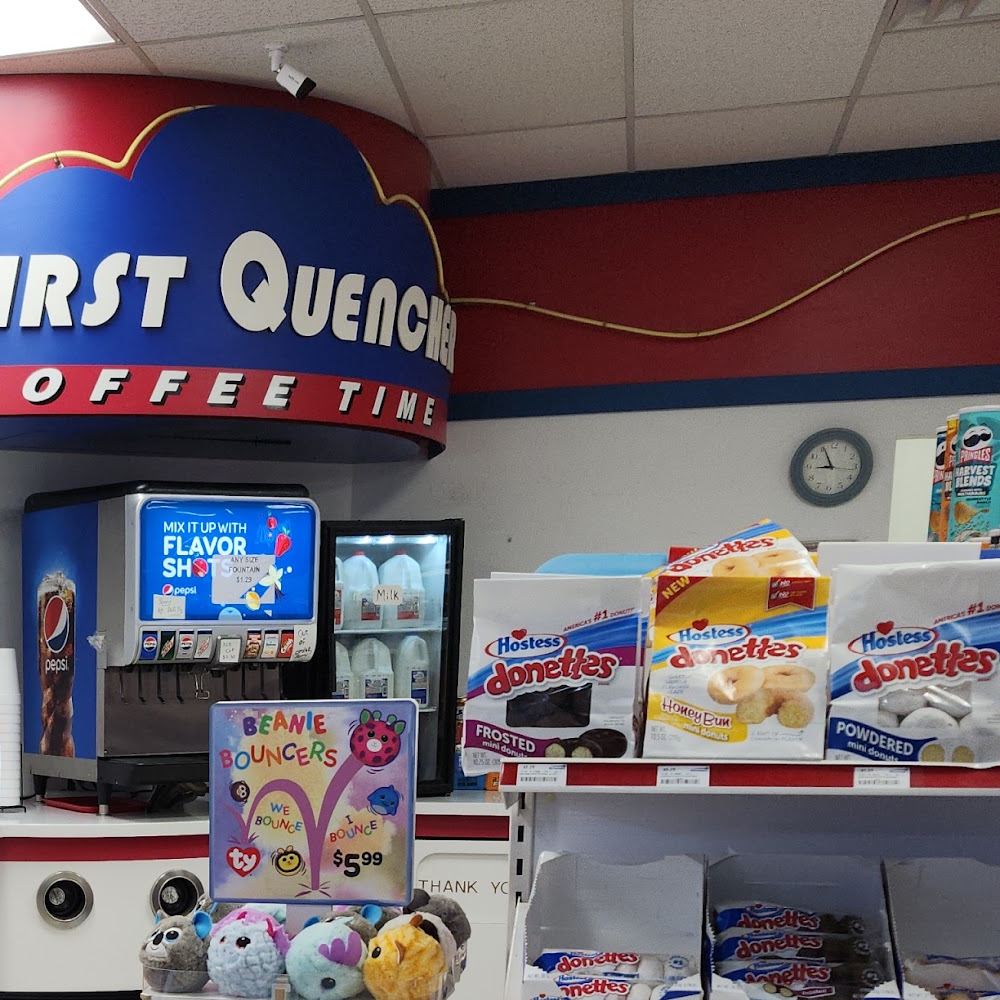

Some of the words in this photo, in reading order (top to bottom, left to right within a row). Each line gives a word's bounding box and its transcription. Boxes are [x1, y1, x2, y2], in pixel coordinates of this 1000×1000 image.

[338, 380, 437, 427] TIME
[960, 448, 992, 463] PRINGLES
[955, 464, 996, 477] HARVEST
[955, 475, 993, 487] BLENDS
[164, 521, 185, 533] MIX
[188, 522, 198, 533] IT
[201, 522, 218, 533] UP
[218, 522, 247, 534] WITH
[163, 536, 247, 556] FLAVOR
[669, 537, 775, 573] donettes
[174, 586, 197, 595] pepsi
[376, 589, 399, 601] Milk
[661, 577, 690, 600] NEW
[594, 610, 609, 622] #1
[967, 601, 984, 616] #1
[678, 625, 744, 643] Hostess
[861, 629, 931, 653] Hostess
[497, 634, 561, 656] Hostess
[669, 637, 801, 669] donettes
[45, 656, 68, 674] pepsi
[487, 648, 616, 697] donettes
[853, 642, 997, 692] donettes
[242, 711, 328, 737] BEANIE
[476, 724, 536, 753] FROSTED
[701, 728, 729, 742] donuts
[836, 721, 914, 756] POWDERED
[482, 740, 500, 750] mini
[847, 740, 867, 752] mini
[218, 740, 338, 770] BOUNCERS
[270, 802, 290, 816] WE
[255, 815, 303, 834] BOUNCE
[345, 815, 353, 825] I
[329, 820, 378, 843] BOUNCE
[229, 848, 257, 871] ty
[418, 879, 478, 894] THANK
[490, 881, 509, 895] YO
[738, 911, 819, 930] donettes
[735, 934, 823, 961] donettes
[557, 952, 639, 973] donettes
[745, 963, 830, 984] donettes
